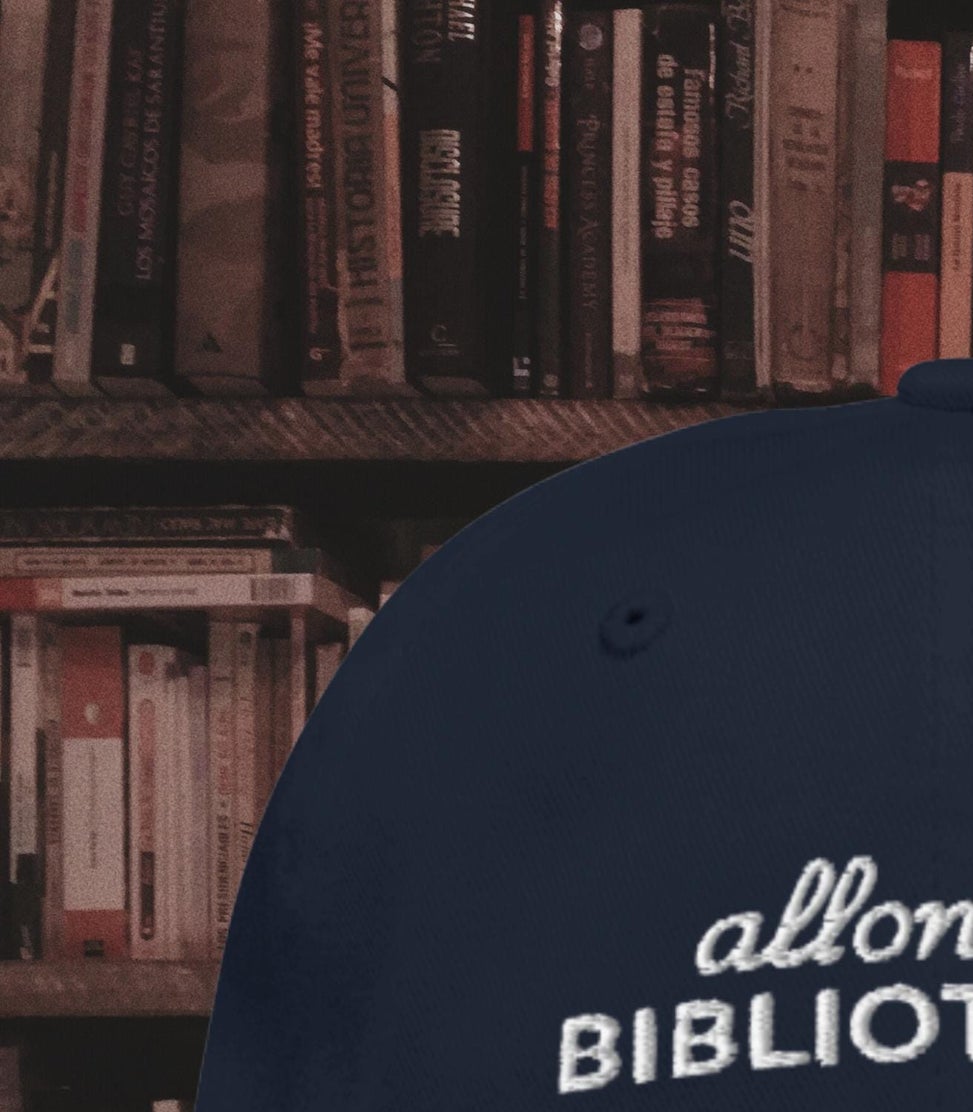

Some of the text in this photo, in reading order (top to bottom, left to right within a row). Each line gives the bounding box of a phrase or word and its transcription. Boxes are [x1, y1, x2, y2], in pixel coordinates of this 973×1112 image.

[656, 53, 680, 80] de
[656, 84, 682, 151] estafa
[418, 128, 462, 239] DISCLOSURE
[650, 158, 676, 173] y
[683, 165, 704, 229] casos
